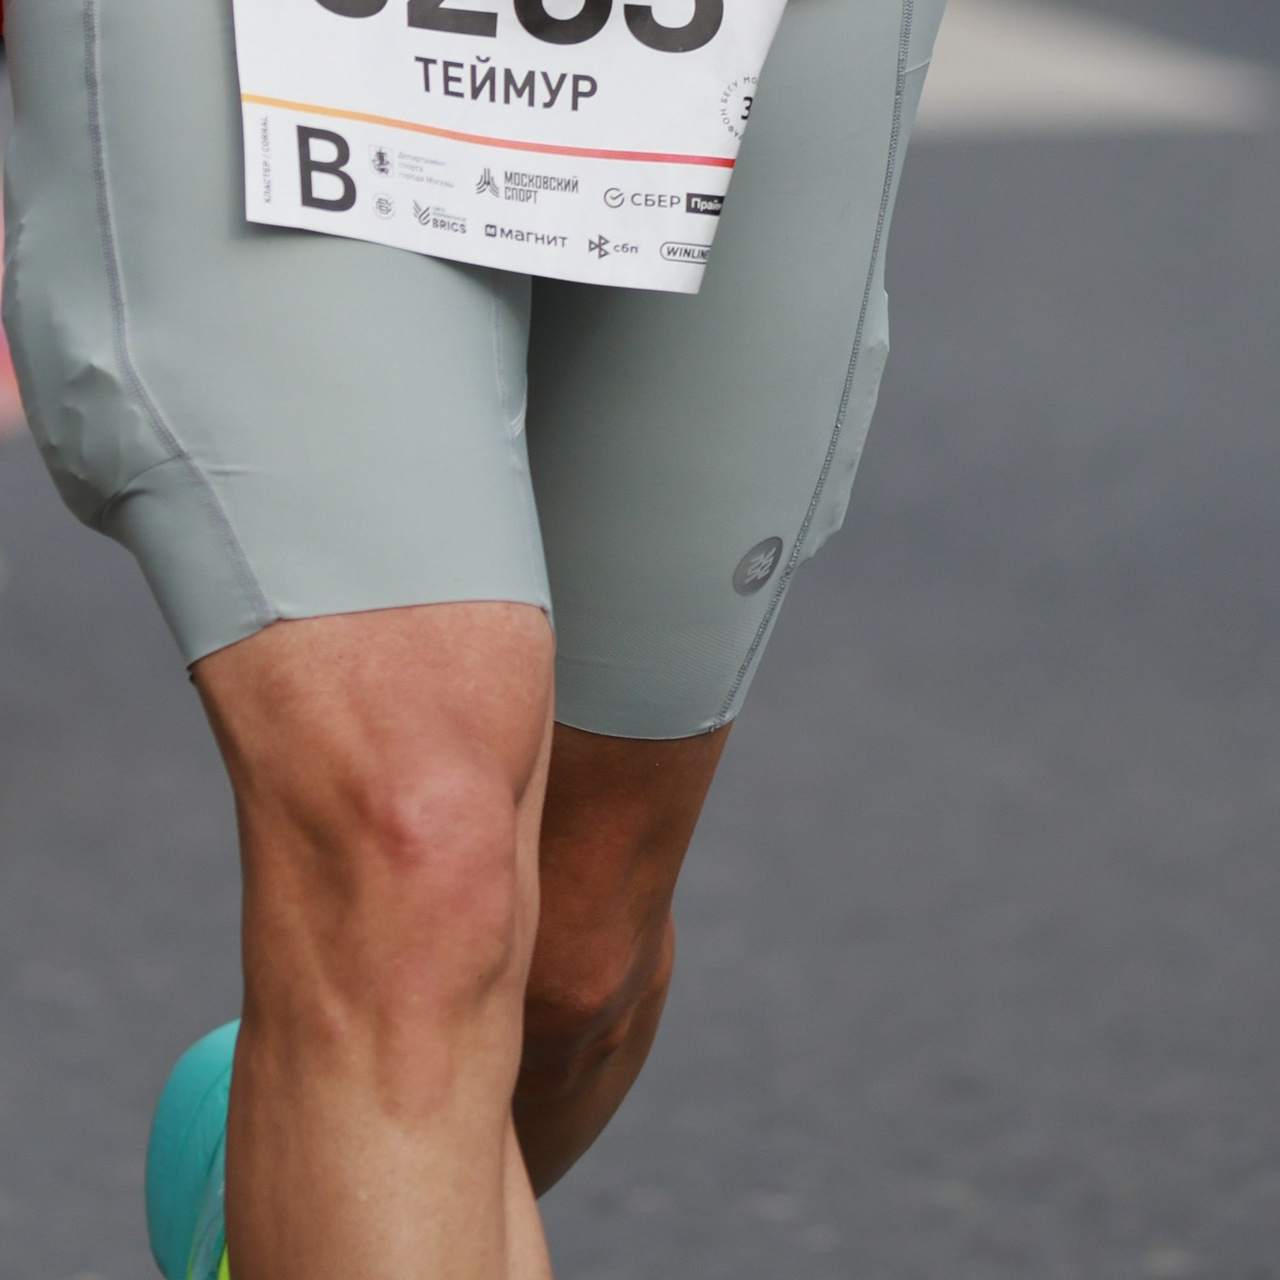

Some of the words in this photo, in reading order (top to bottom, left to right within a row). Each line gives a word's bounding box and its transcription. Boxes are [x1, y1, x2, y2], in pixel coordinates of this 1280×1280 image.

[414, 55, 598, 112] ТЕЙМУР
[504, 171, 579, 193] МОСКОВСКИЙ
[504, 186, 538, 204] СПОРТ
[630, 193, 681, 208] СБЕР
[432, 218, 466, 234] BRICS
